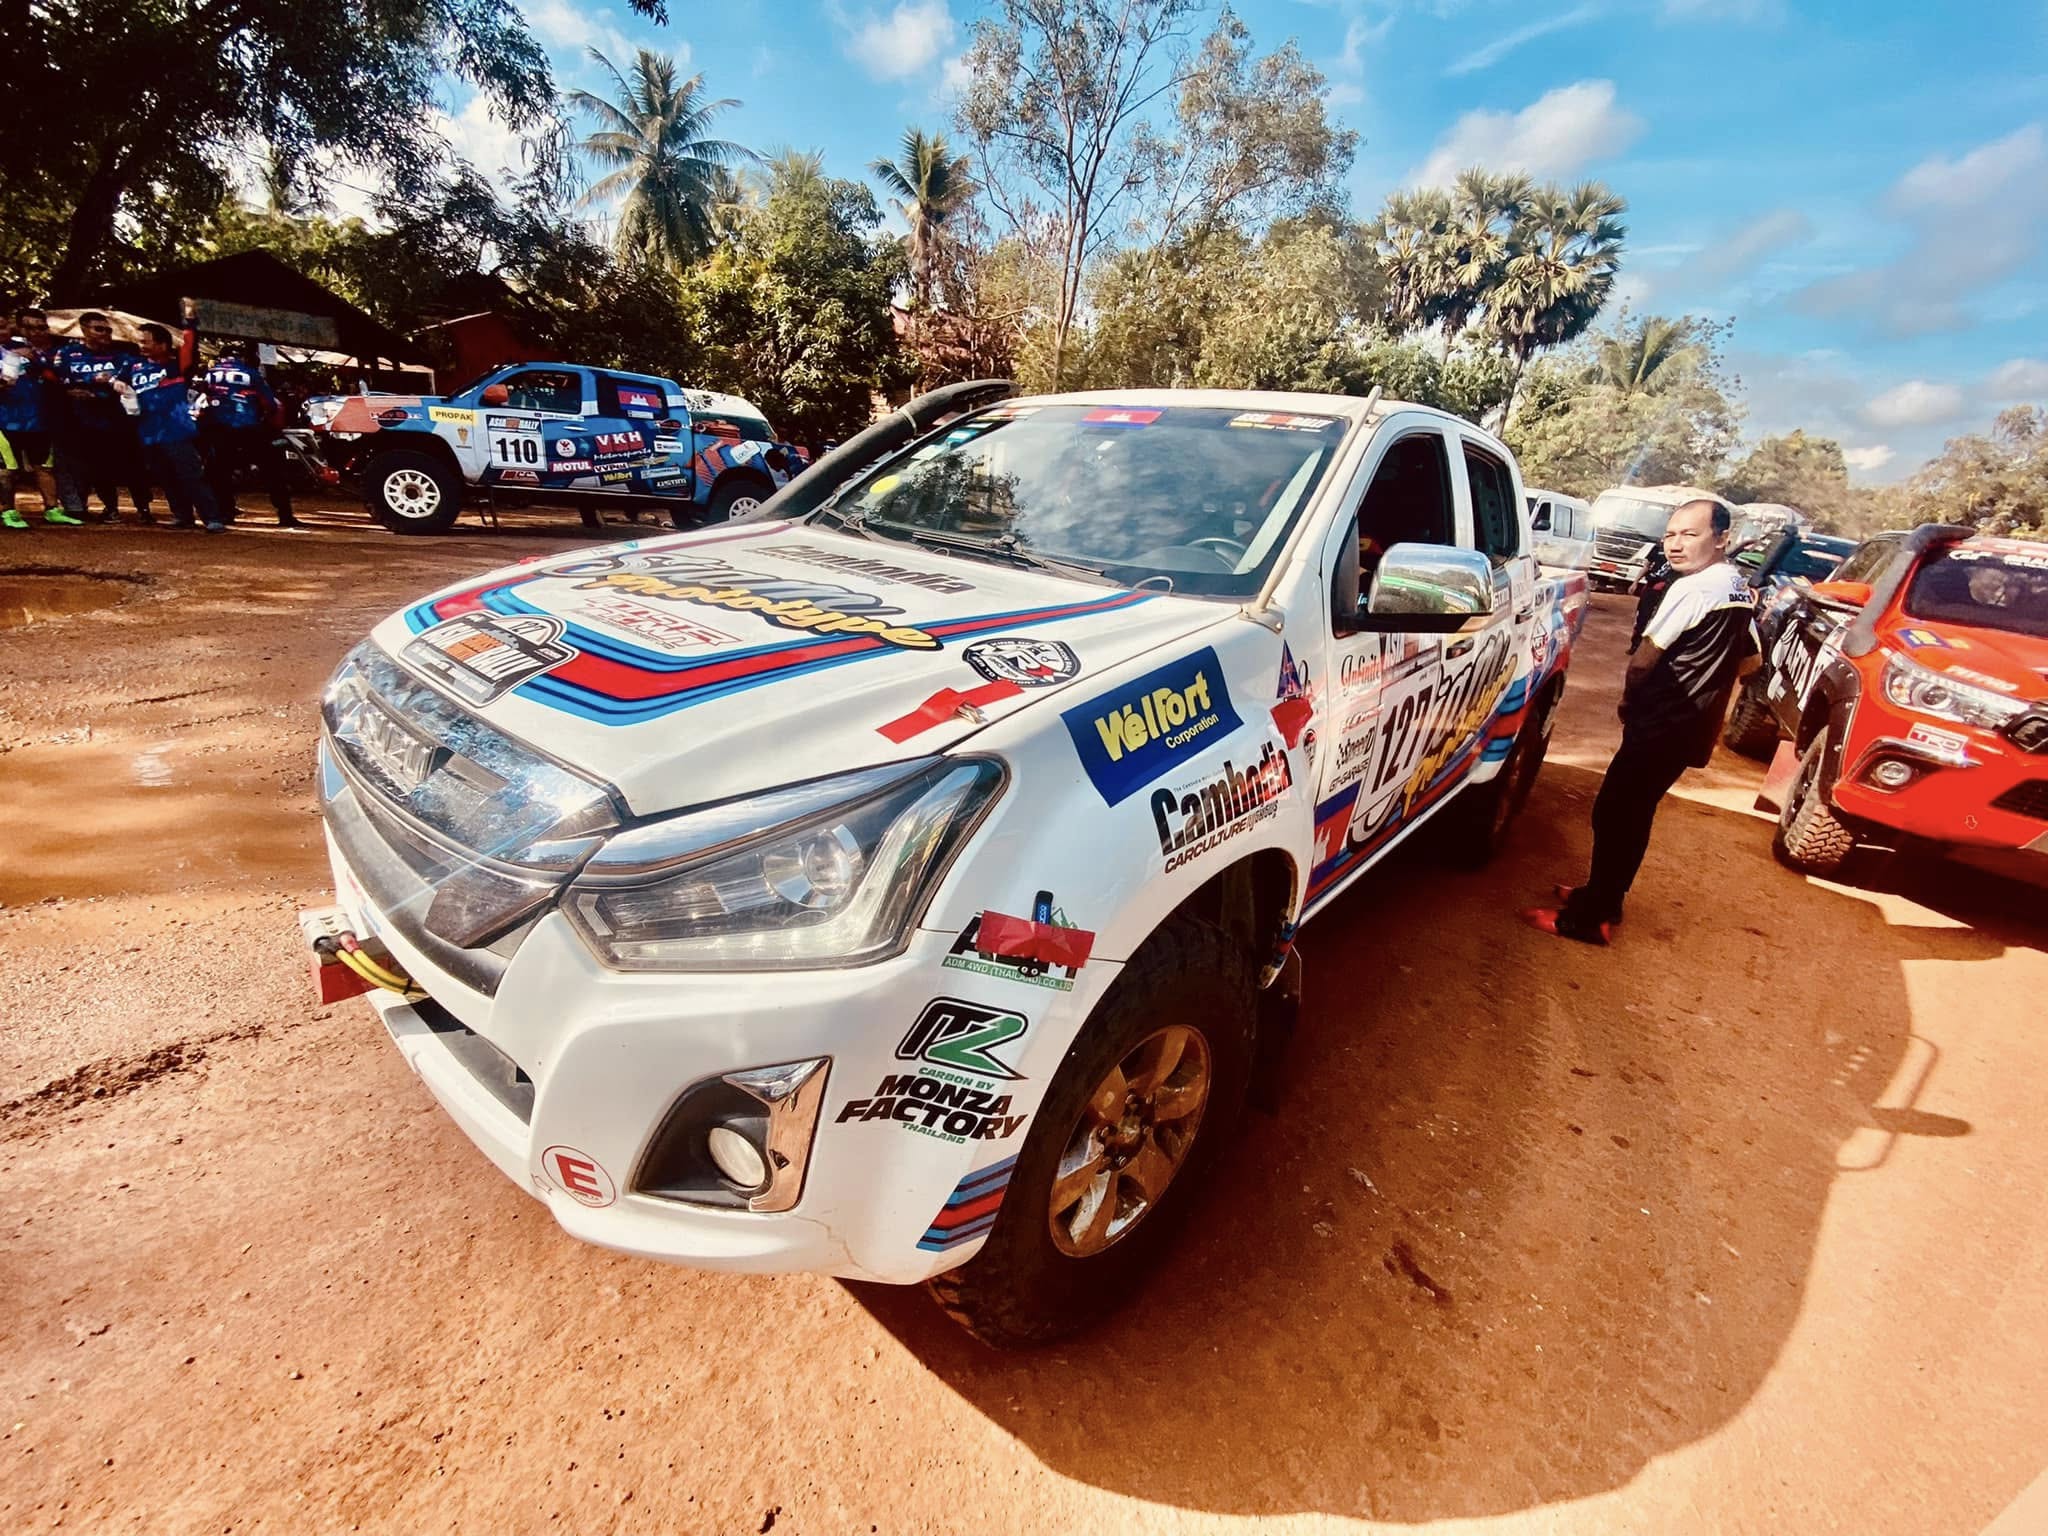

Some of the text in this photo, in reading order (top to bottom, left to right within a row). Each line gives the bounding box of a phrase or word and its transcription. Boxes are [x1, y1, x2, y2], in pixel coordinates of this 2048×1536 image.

[70, 362, 115, 373] KARA
[435, 411, 473, 421] PROPAK
[496, 437, 539, 464] 110
[595, 431, 641, 446] VKH
[552, 461, 592, 473] MOTUL
[1165, 713, 1220, 749] Corporation
[1371, 685, 1433, 794] 127
[1151, 740, 1293, 857] Cambodia
[944, 958, 966, 970] ADM
[967, 963, 988, 974] 4WD
[918, 1066, 996, 1091] CARBON BY
[874, 1074, 1013, 1116] MONZA
[834, 1096, 1029, 1140] FACTORY
[902, 1122, 967, 1145] THAILAND
[554, 1153, 604, 1199] E
